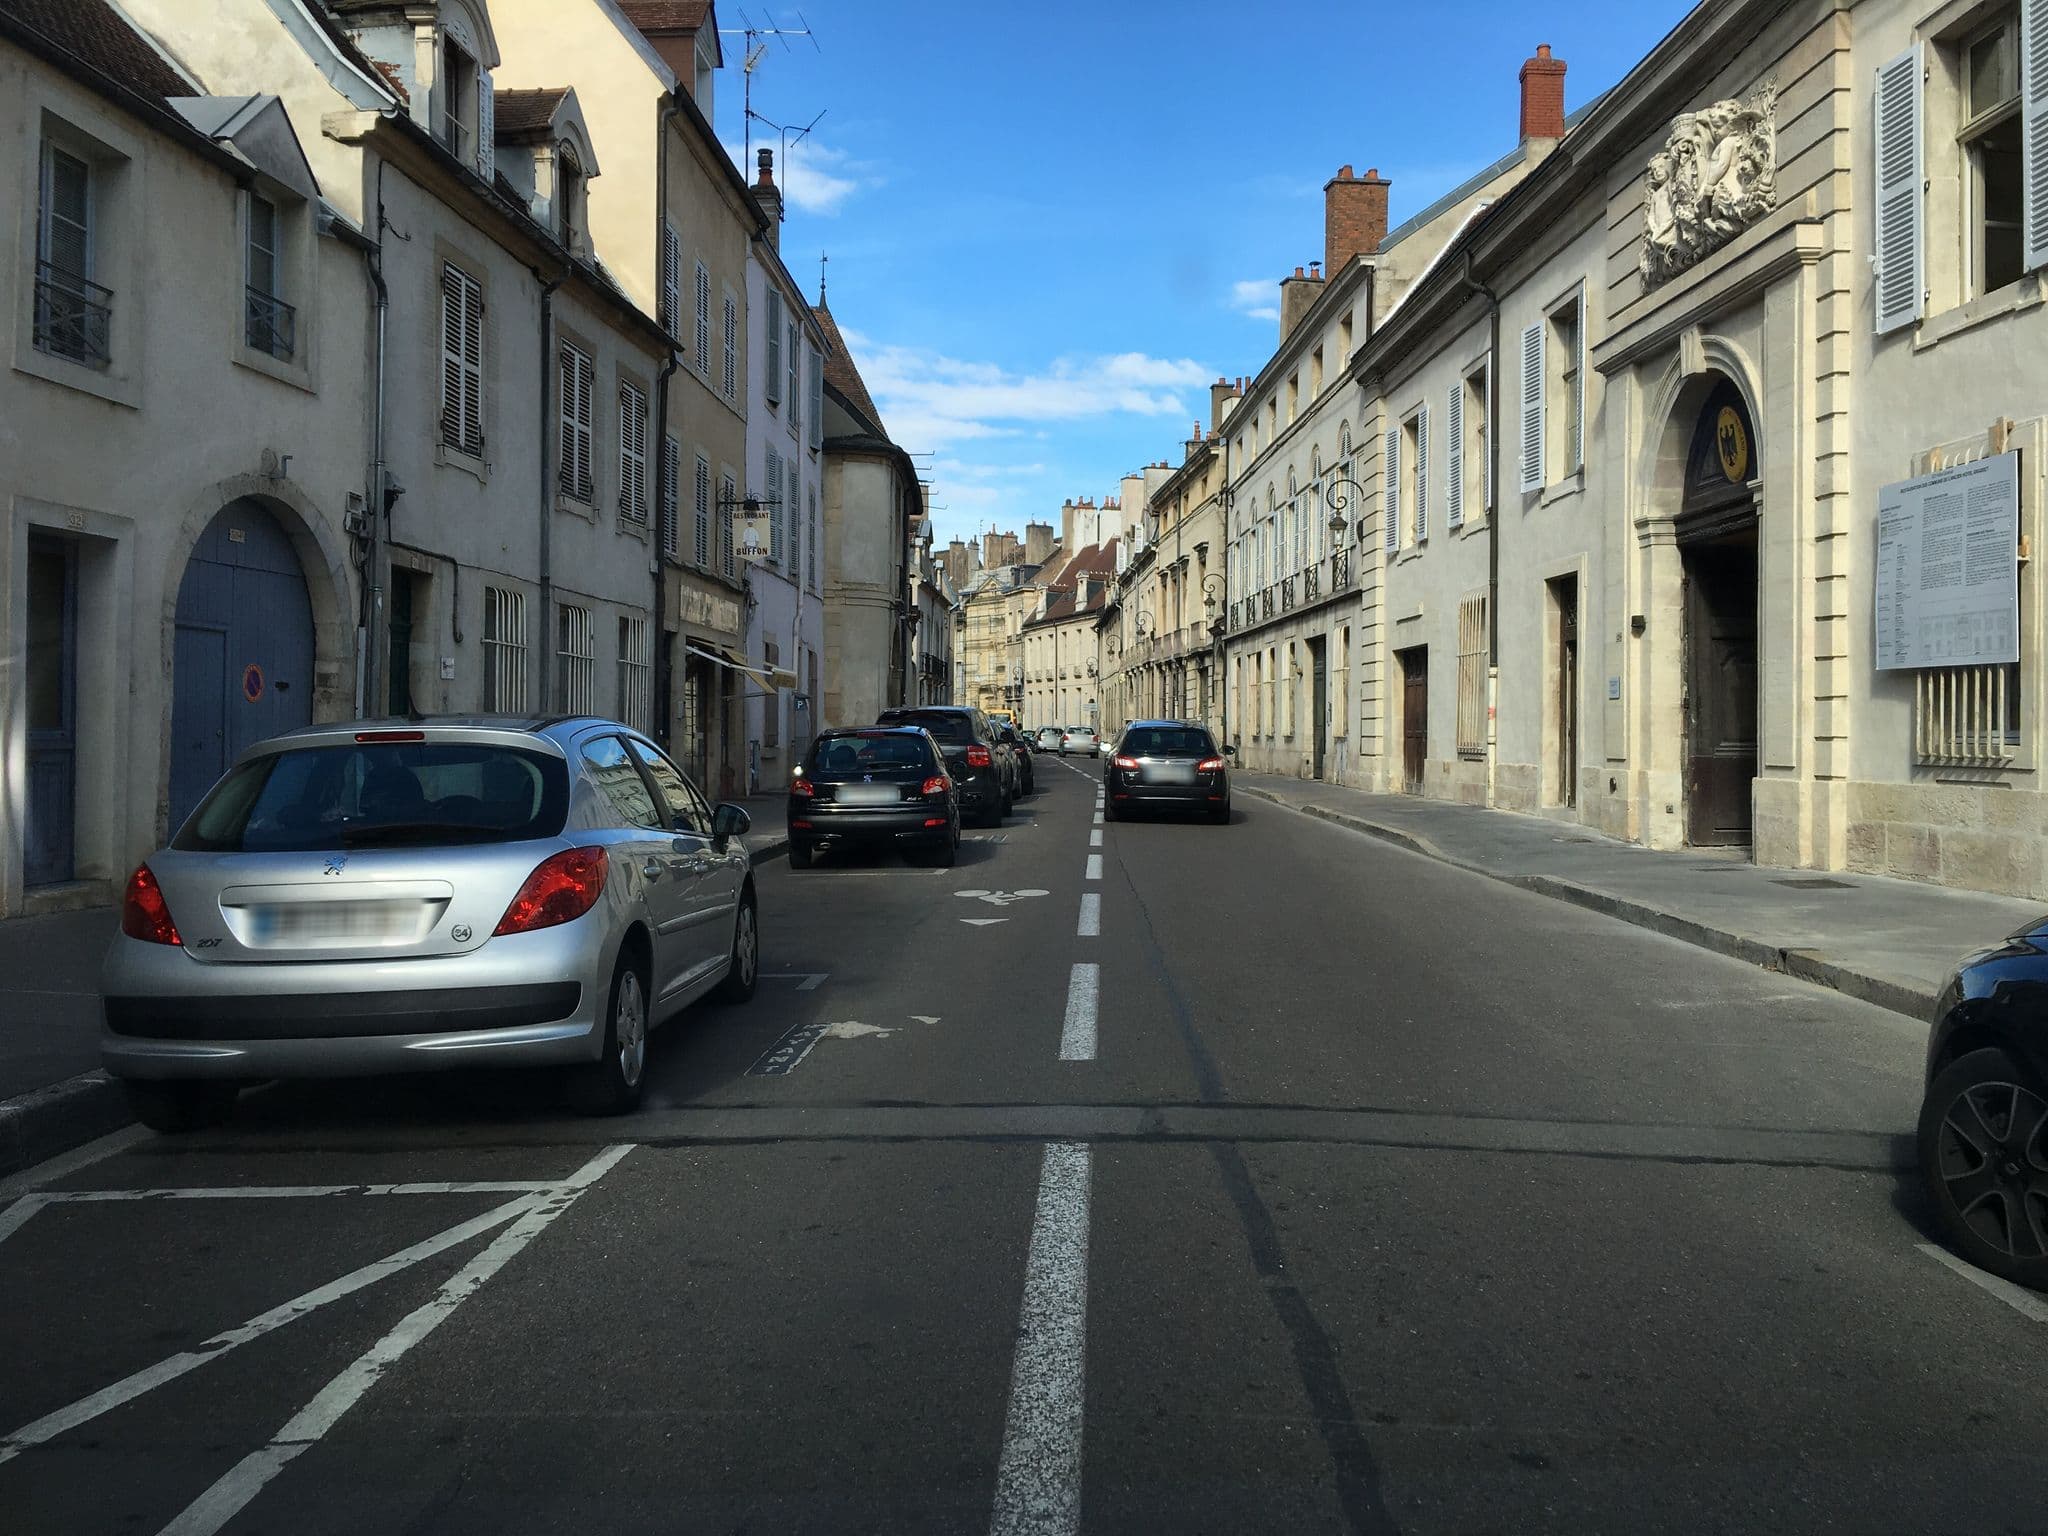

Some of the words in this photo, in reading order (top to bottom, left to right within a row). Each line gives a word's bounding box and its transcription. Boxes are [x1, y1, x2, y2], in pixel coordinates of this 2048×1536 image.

[736, 547, 768, 556] BUFFON
[797, 700, 804, 709] P
[197, 938, 223, 948] 207
